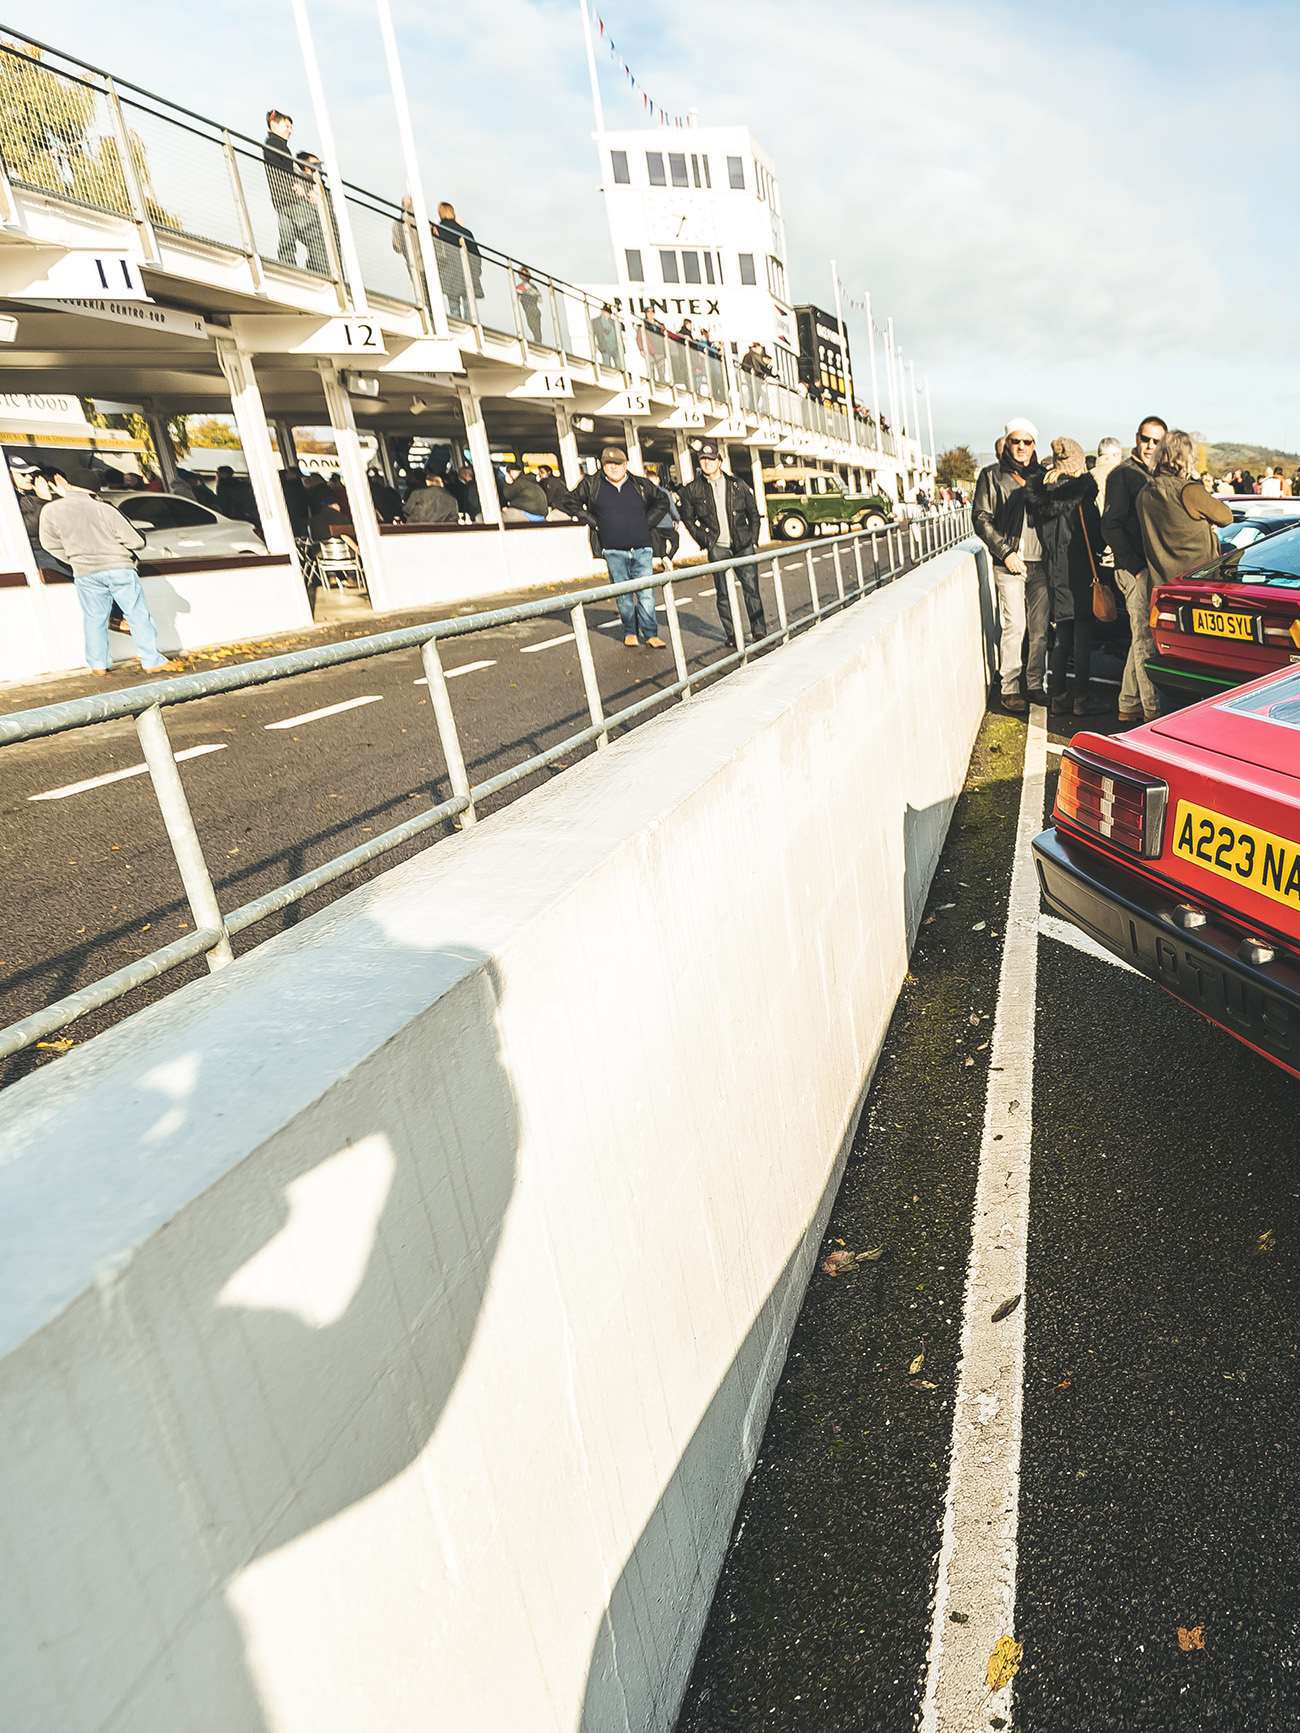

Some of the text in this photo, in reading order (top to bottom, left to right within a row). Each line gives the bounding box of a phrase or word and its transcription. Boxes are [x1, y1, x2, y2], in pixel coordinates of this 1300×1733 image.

[95, 259, 134, 290] 11
[344, 324, 377, 347] 12
[545, 376, 566, 391] 14
[626, 396, 645, 409] 15
[684, 411, 700, 423] 16
[1197, 612, 1225, 633] A130
[1178, 812, 1255, 878] A223
